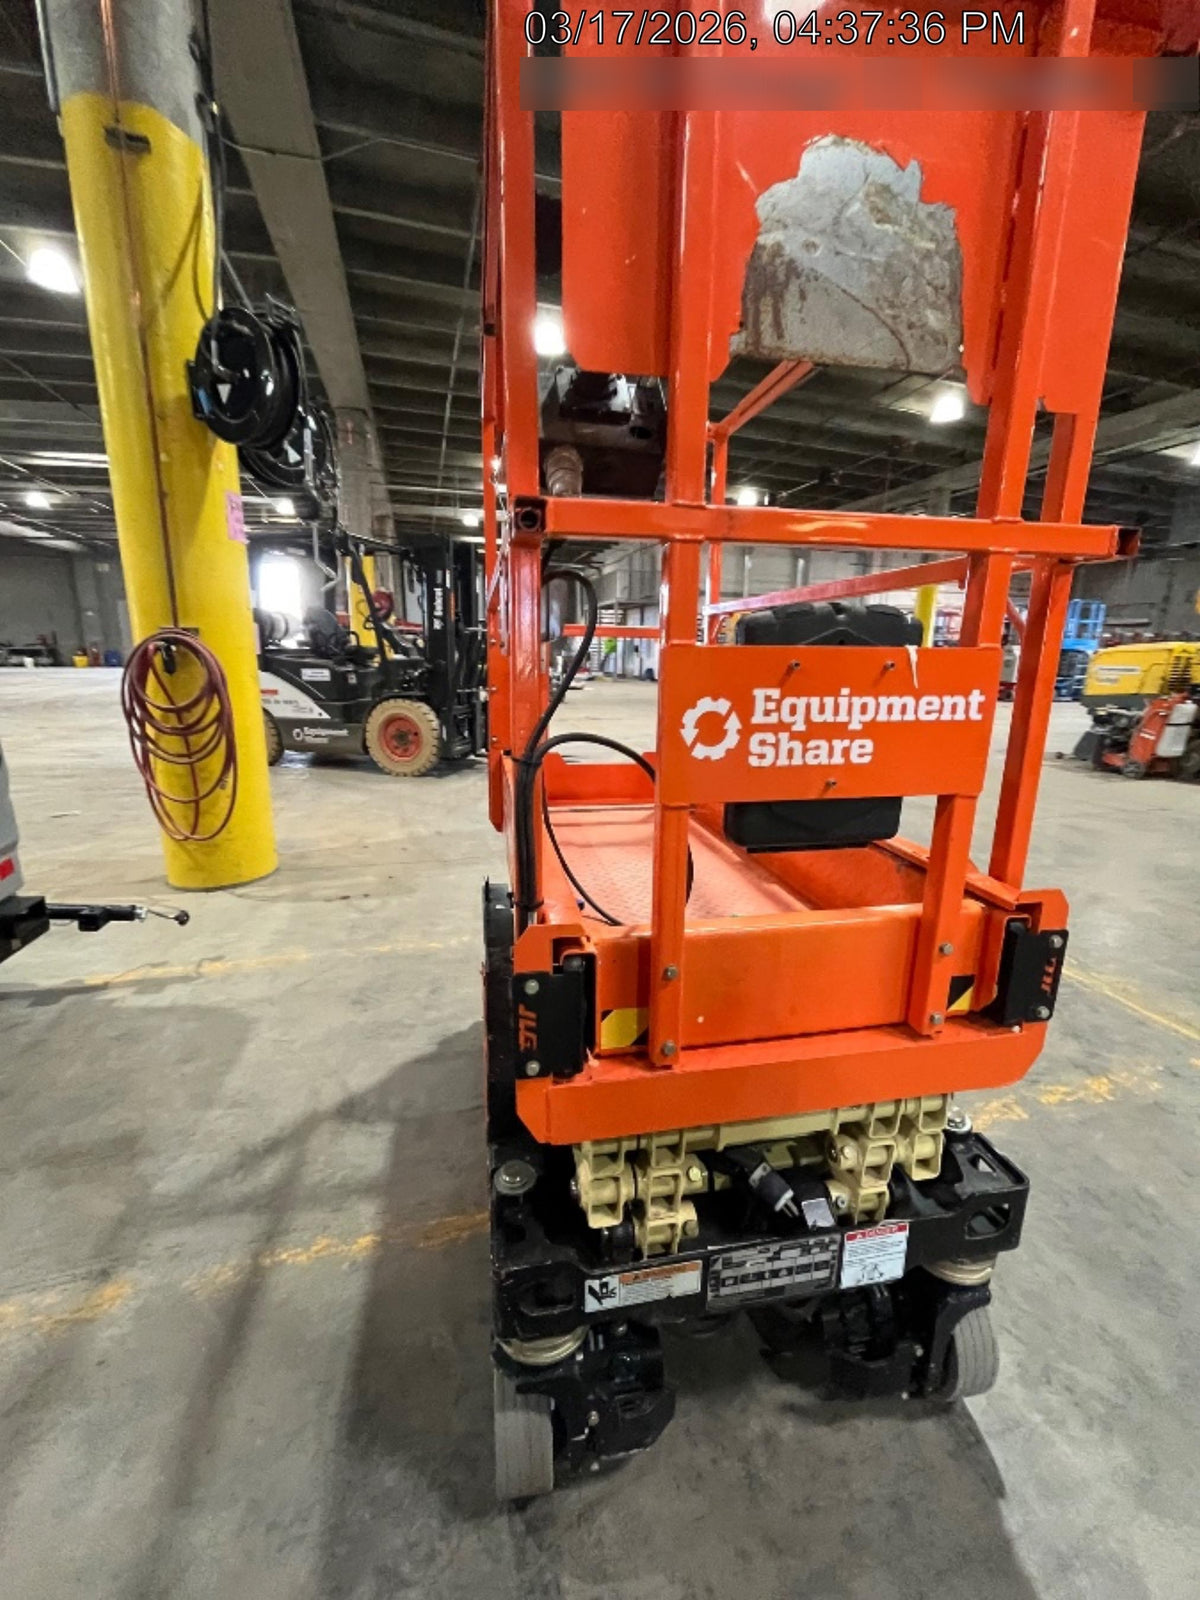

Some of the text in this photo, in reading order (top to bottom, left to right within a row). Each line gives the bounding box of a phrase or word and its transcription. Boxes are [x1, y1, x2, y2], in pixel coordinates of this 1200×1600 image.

[751, 687, 985, 731] Equipment
[748, 732, 874, 768] Share
[518, 1003, 538, 1051] JLG
